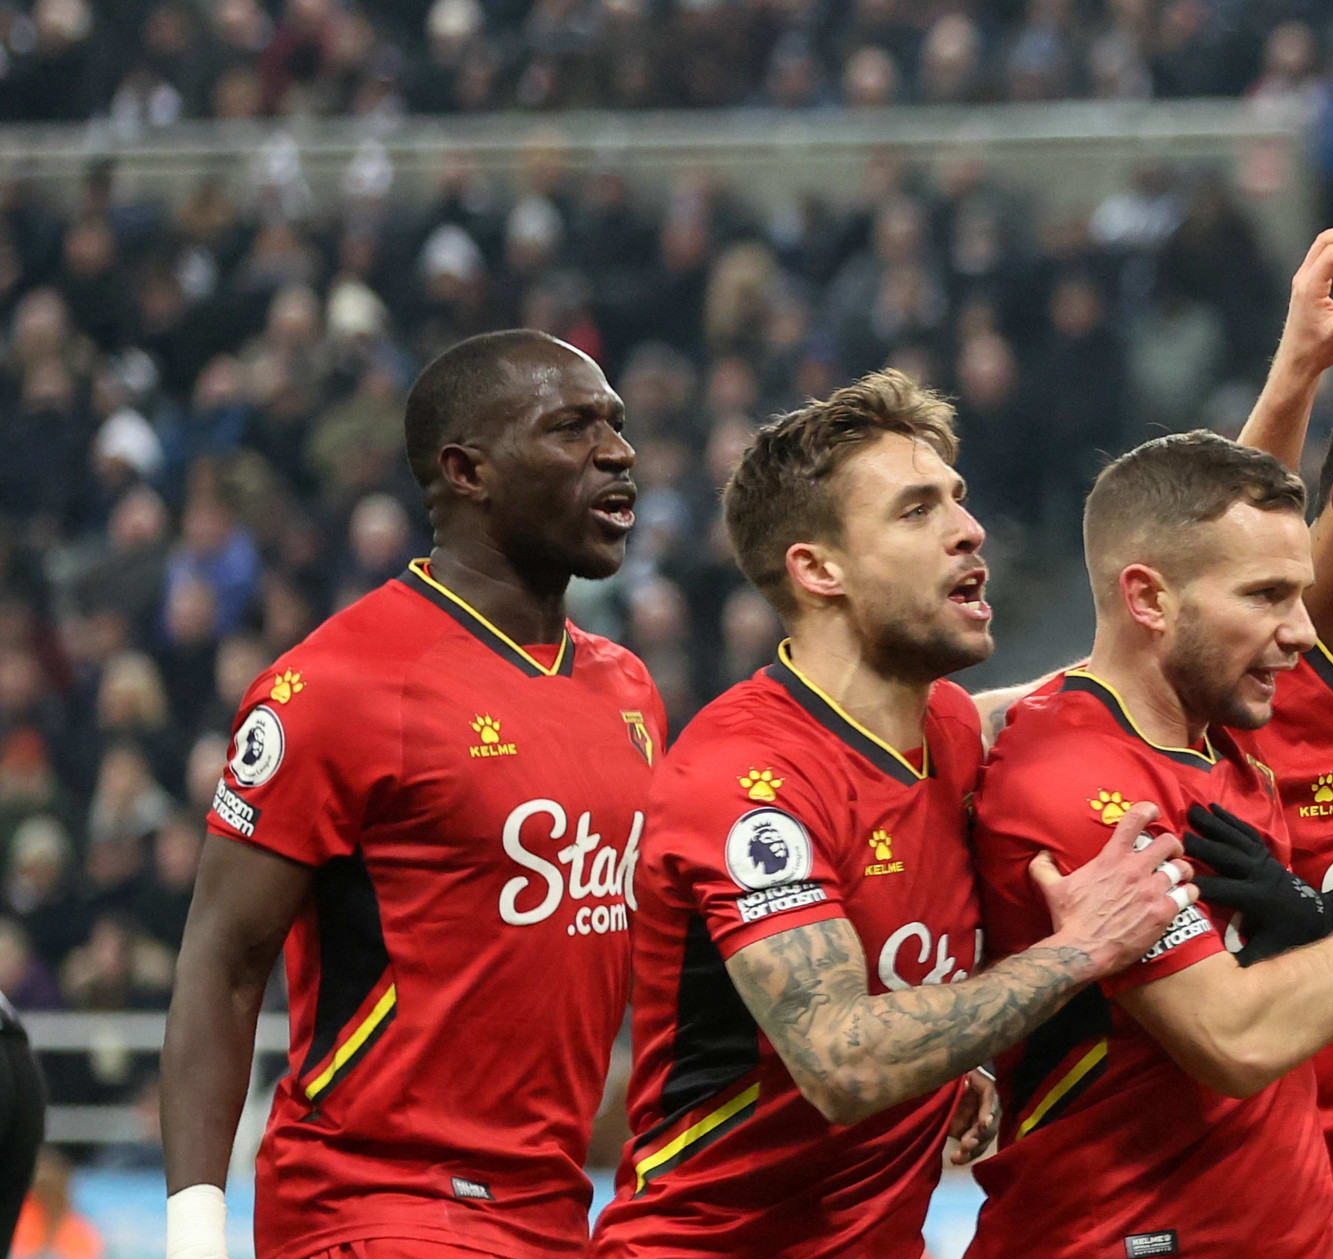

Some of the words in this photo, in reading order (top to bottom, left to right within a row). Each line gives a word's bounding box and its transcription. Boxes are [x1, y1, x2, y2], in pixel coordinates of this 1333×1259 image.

[469, 743, 518, 758] KELME
[498, 798, 645, 925] Stak
[865, 861, 904, 876] KELME
[567, 903, 629, 936] .com
